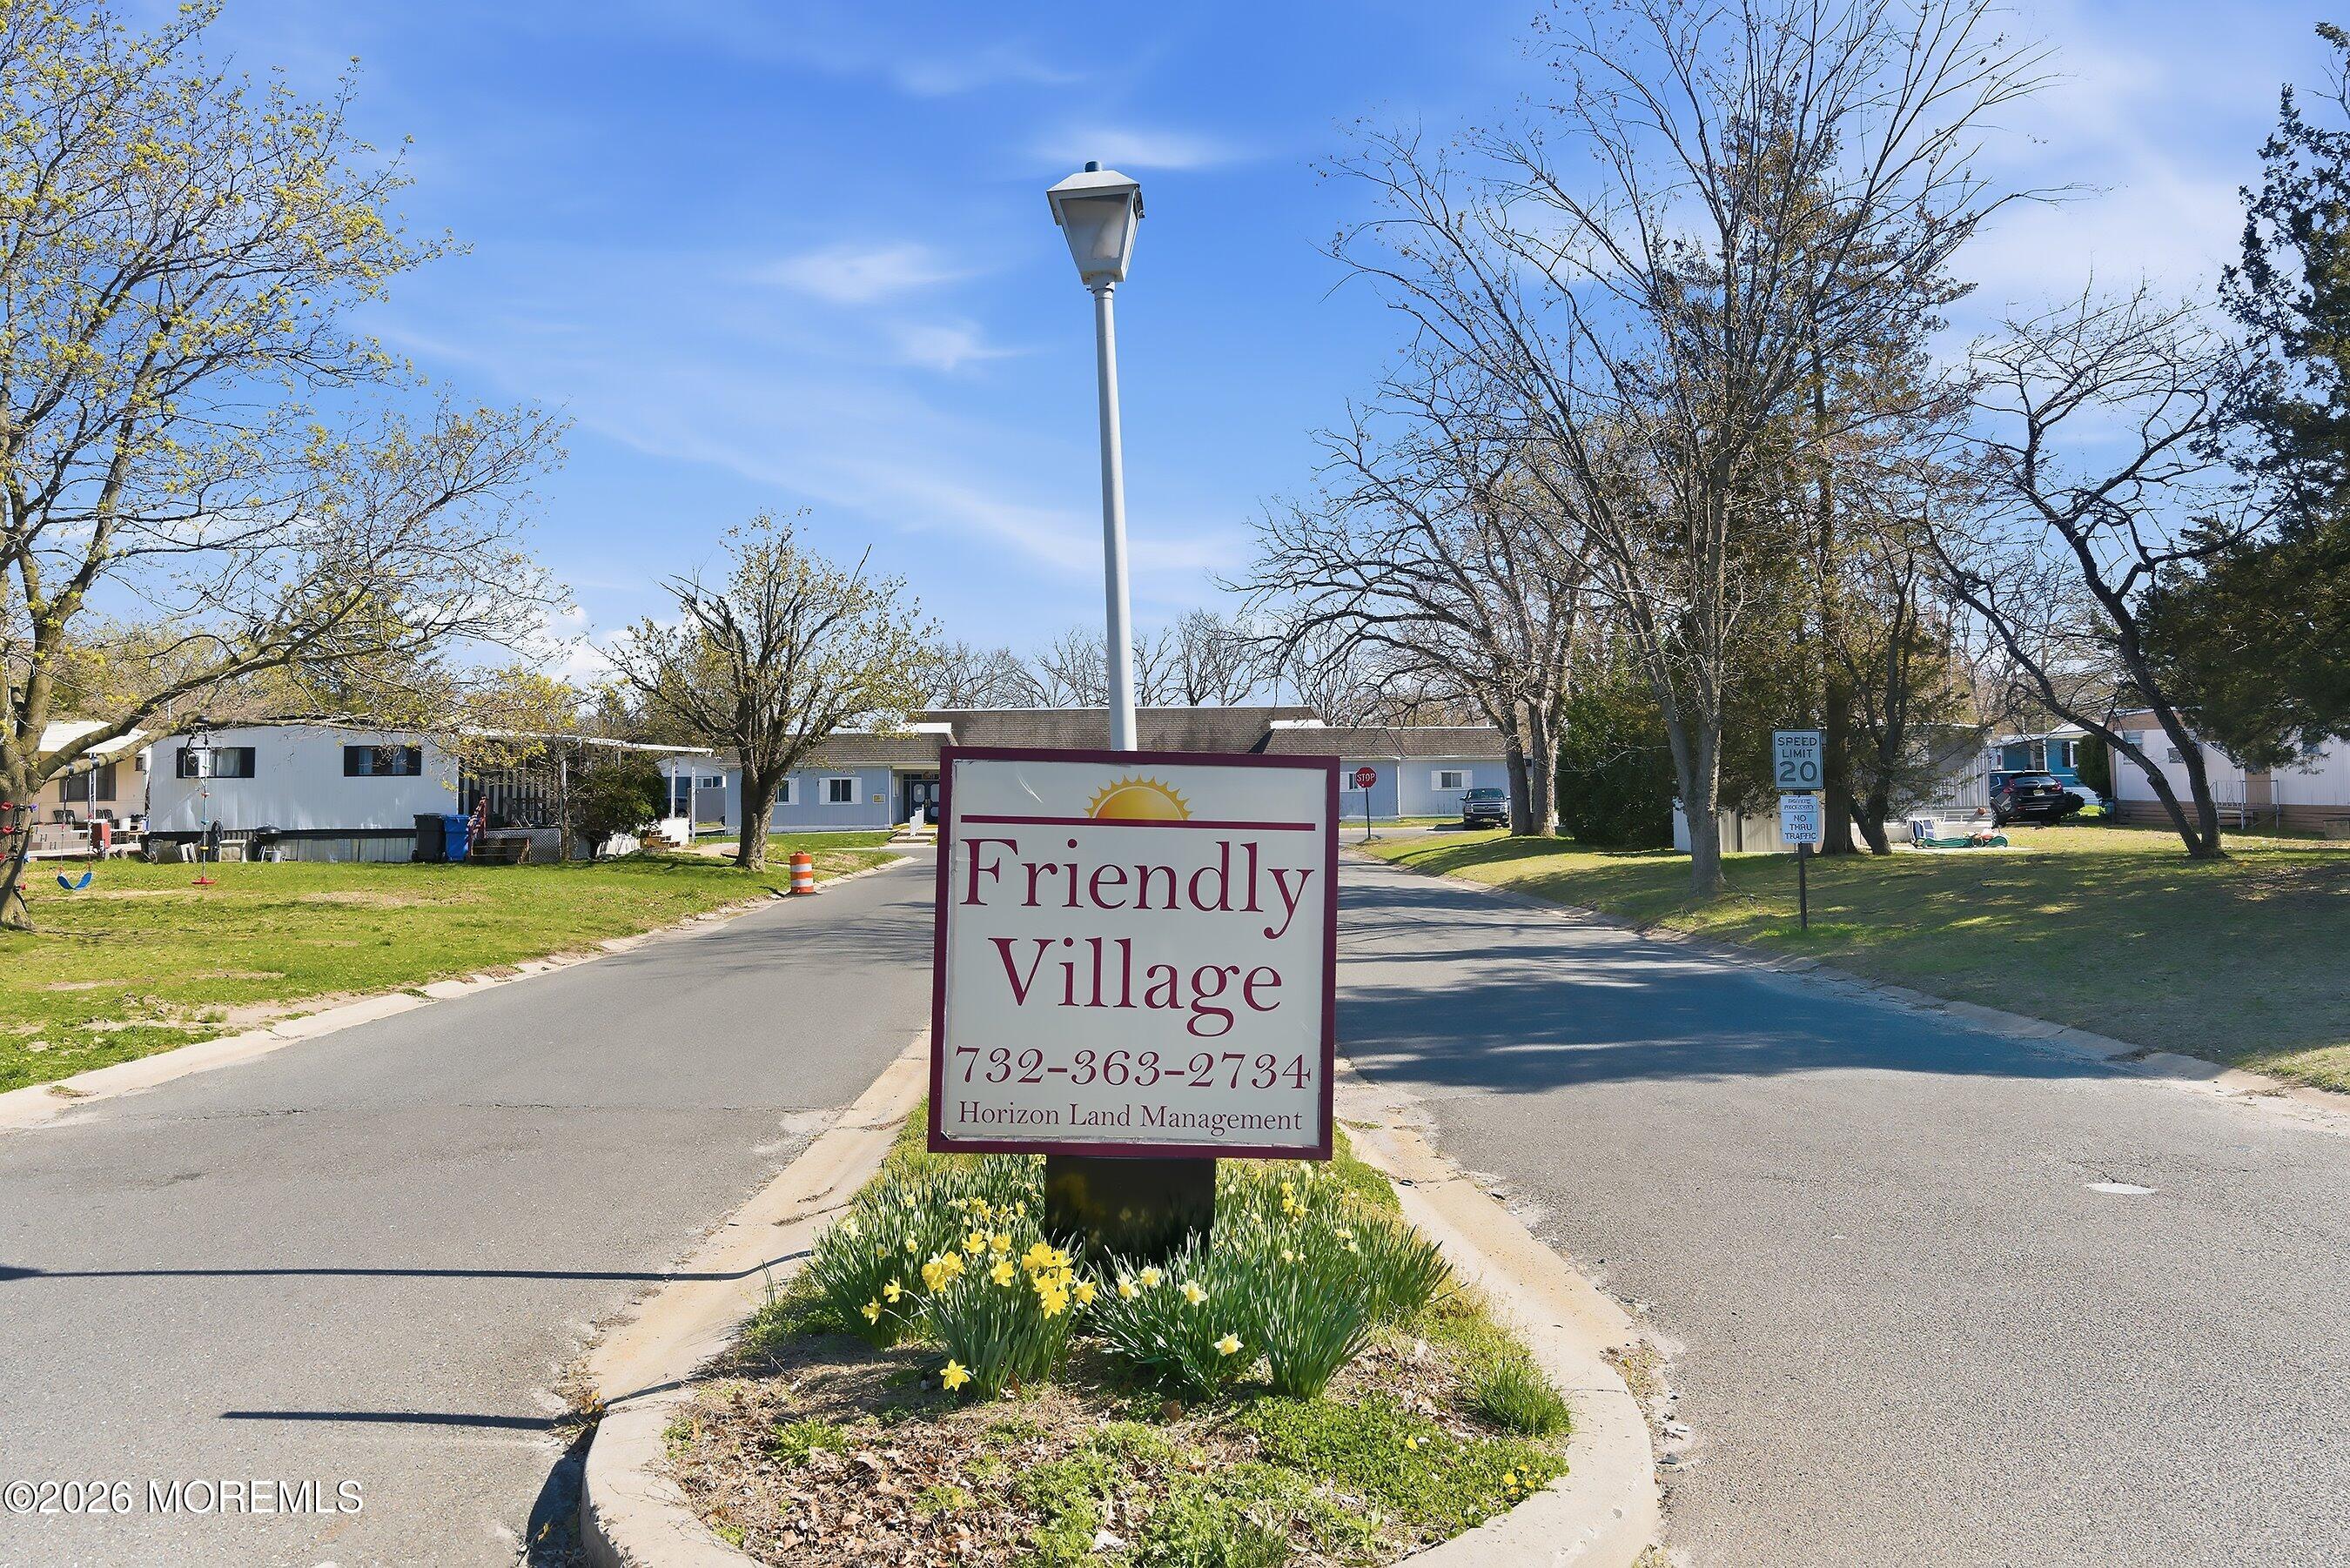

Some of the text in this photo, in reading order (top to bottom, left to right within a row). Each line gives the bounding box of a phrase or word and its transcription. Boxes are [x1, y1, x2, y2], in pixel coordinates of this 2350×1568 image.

[1777, 737, 1817, 747] SPEED
[1783, 749, 1813, 758] LIMIT
[1357, 774, 1375, 782] STOP
[1779, 761, 1817, 782] 20
[1784, 832, 1816, 841] TRAFFIC
[959, 837, 1314, 940] Friendly
[988, 936, 1283, 1037] Village
[956, 1046, 1312, 1089] 732-363-2734
[959, 1102, 1303, 1136] Horizon Land Management
